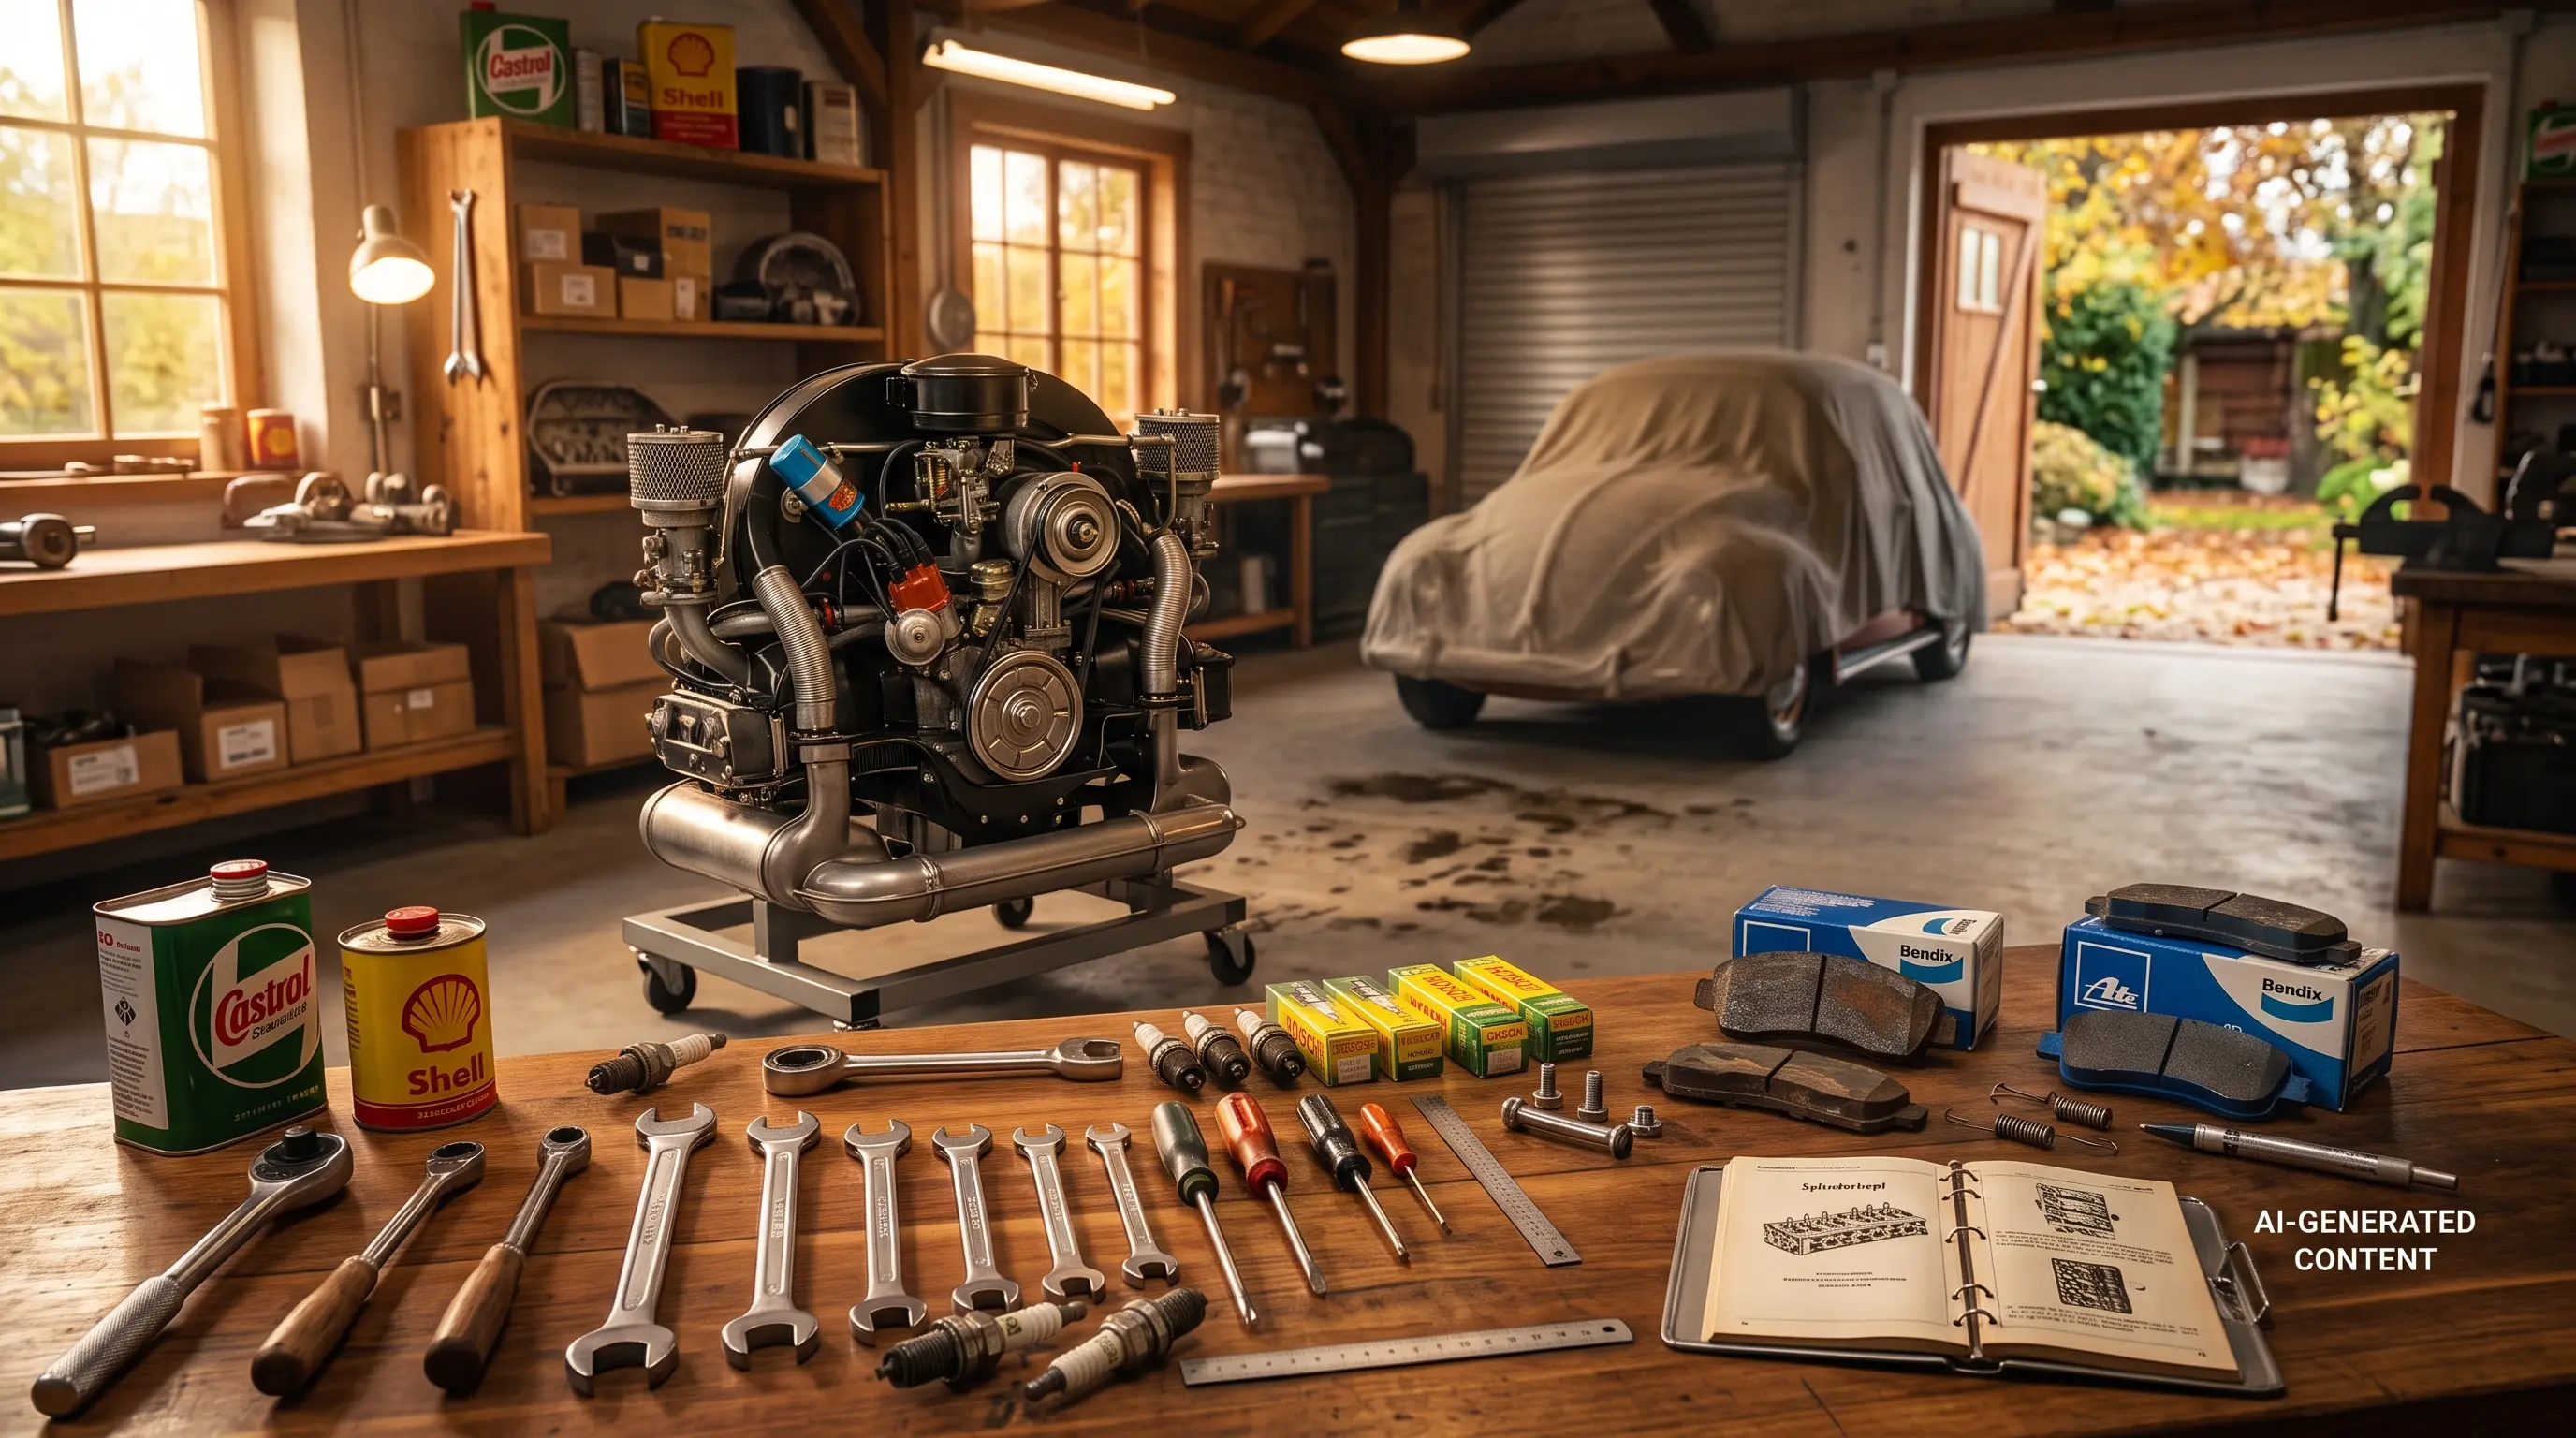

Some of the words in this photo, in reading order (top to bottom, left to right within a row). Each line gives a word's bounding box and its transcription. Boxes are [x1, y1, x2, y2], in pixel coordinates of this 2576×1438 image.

[489, 51, 551, 80] Castrol
[662, 88, 724, 109] Shell
[1900, 944, 1954, 963] Bendix
[215, 953, 312, 1047] Castrol
[2083, 976, 2139, 1010] Ate
[2262, 977, 2323, 1001] Bendix
[407, 1051, 484, 1095] Shell
